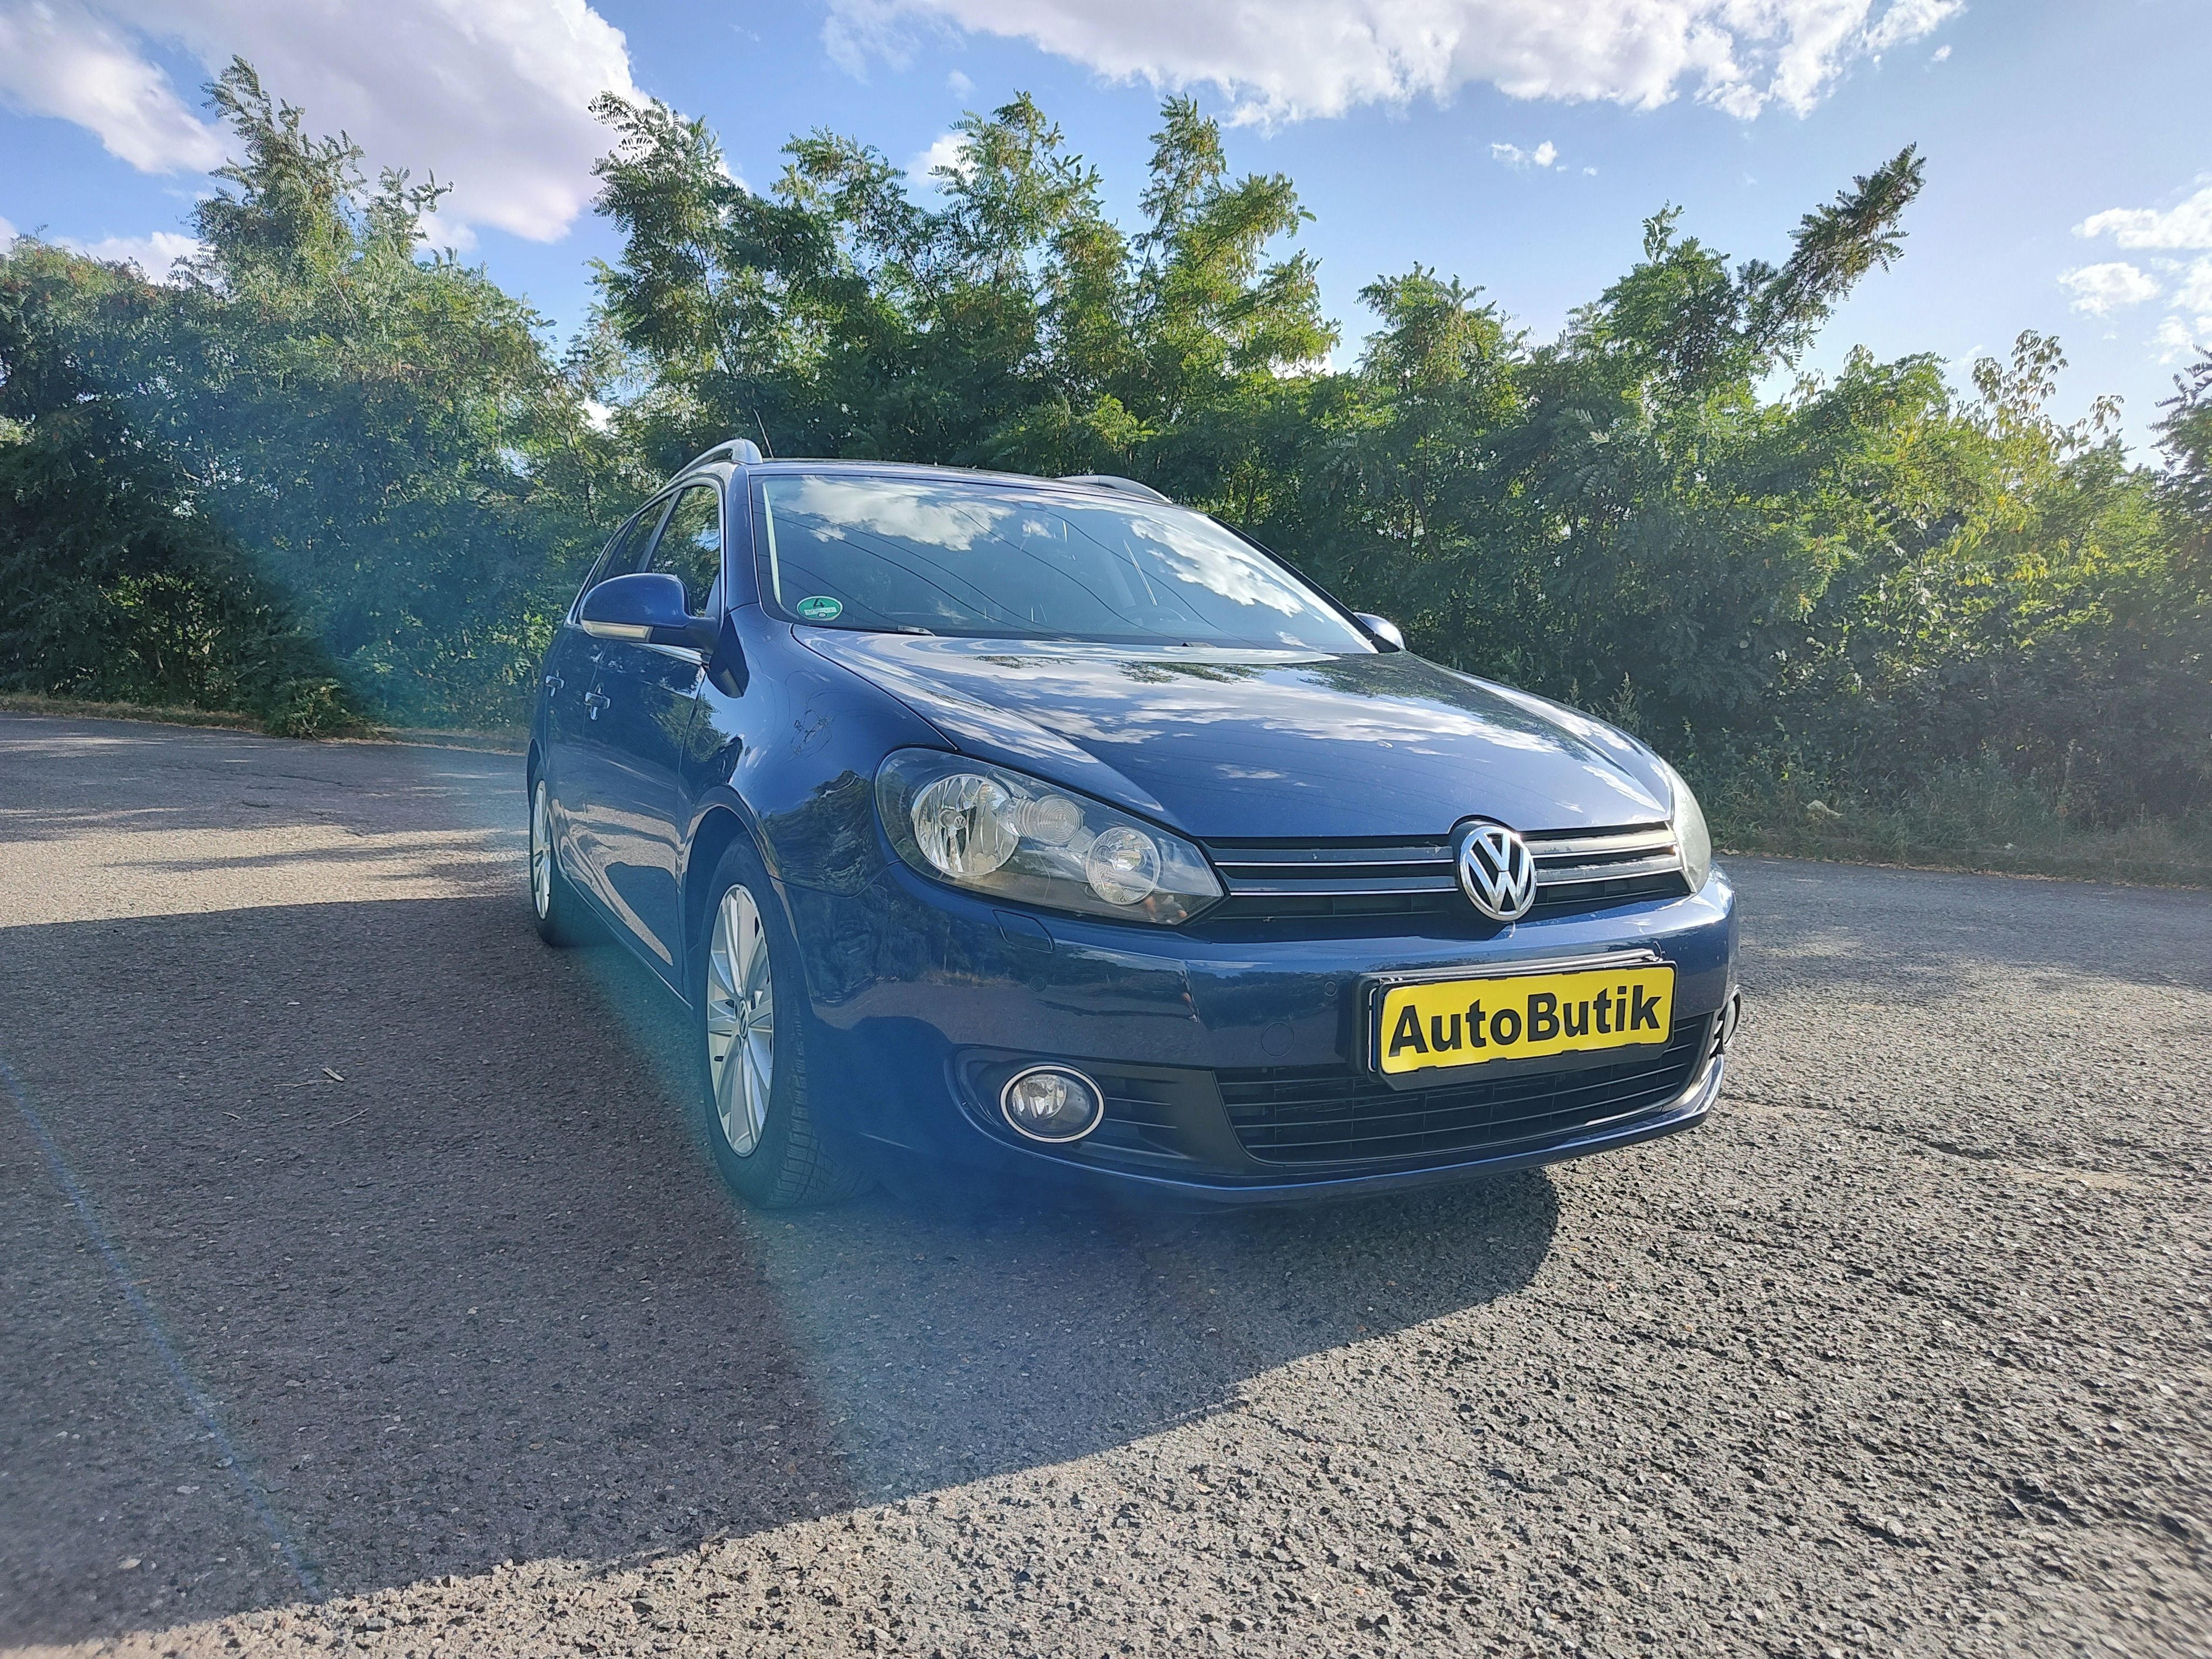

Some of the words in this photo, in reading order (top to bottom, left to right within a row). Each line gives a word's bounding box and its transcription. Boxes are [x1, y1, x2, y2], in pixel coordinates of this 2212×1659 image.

[813, 598, 825, 608] 4
[1464, 829, 1533, 916] VW
[1387, 984, 1662, 1057] AutoButik
